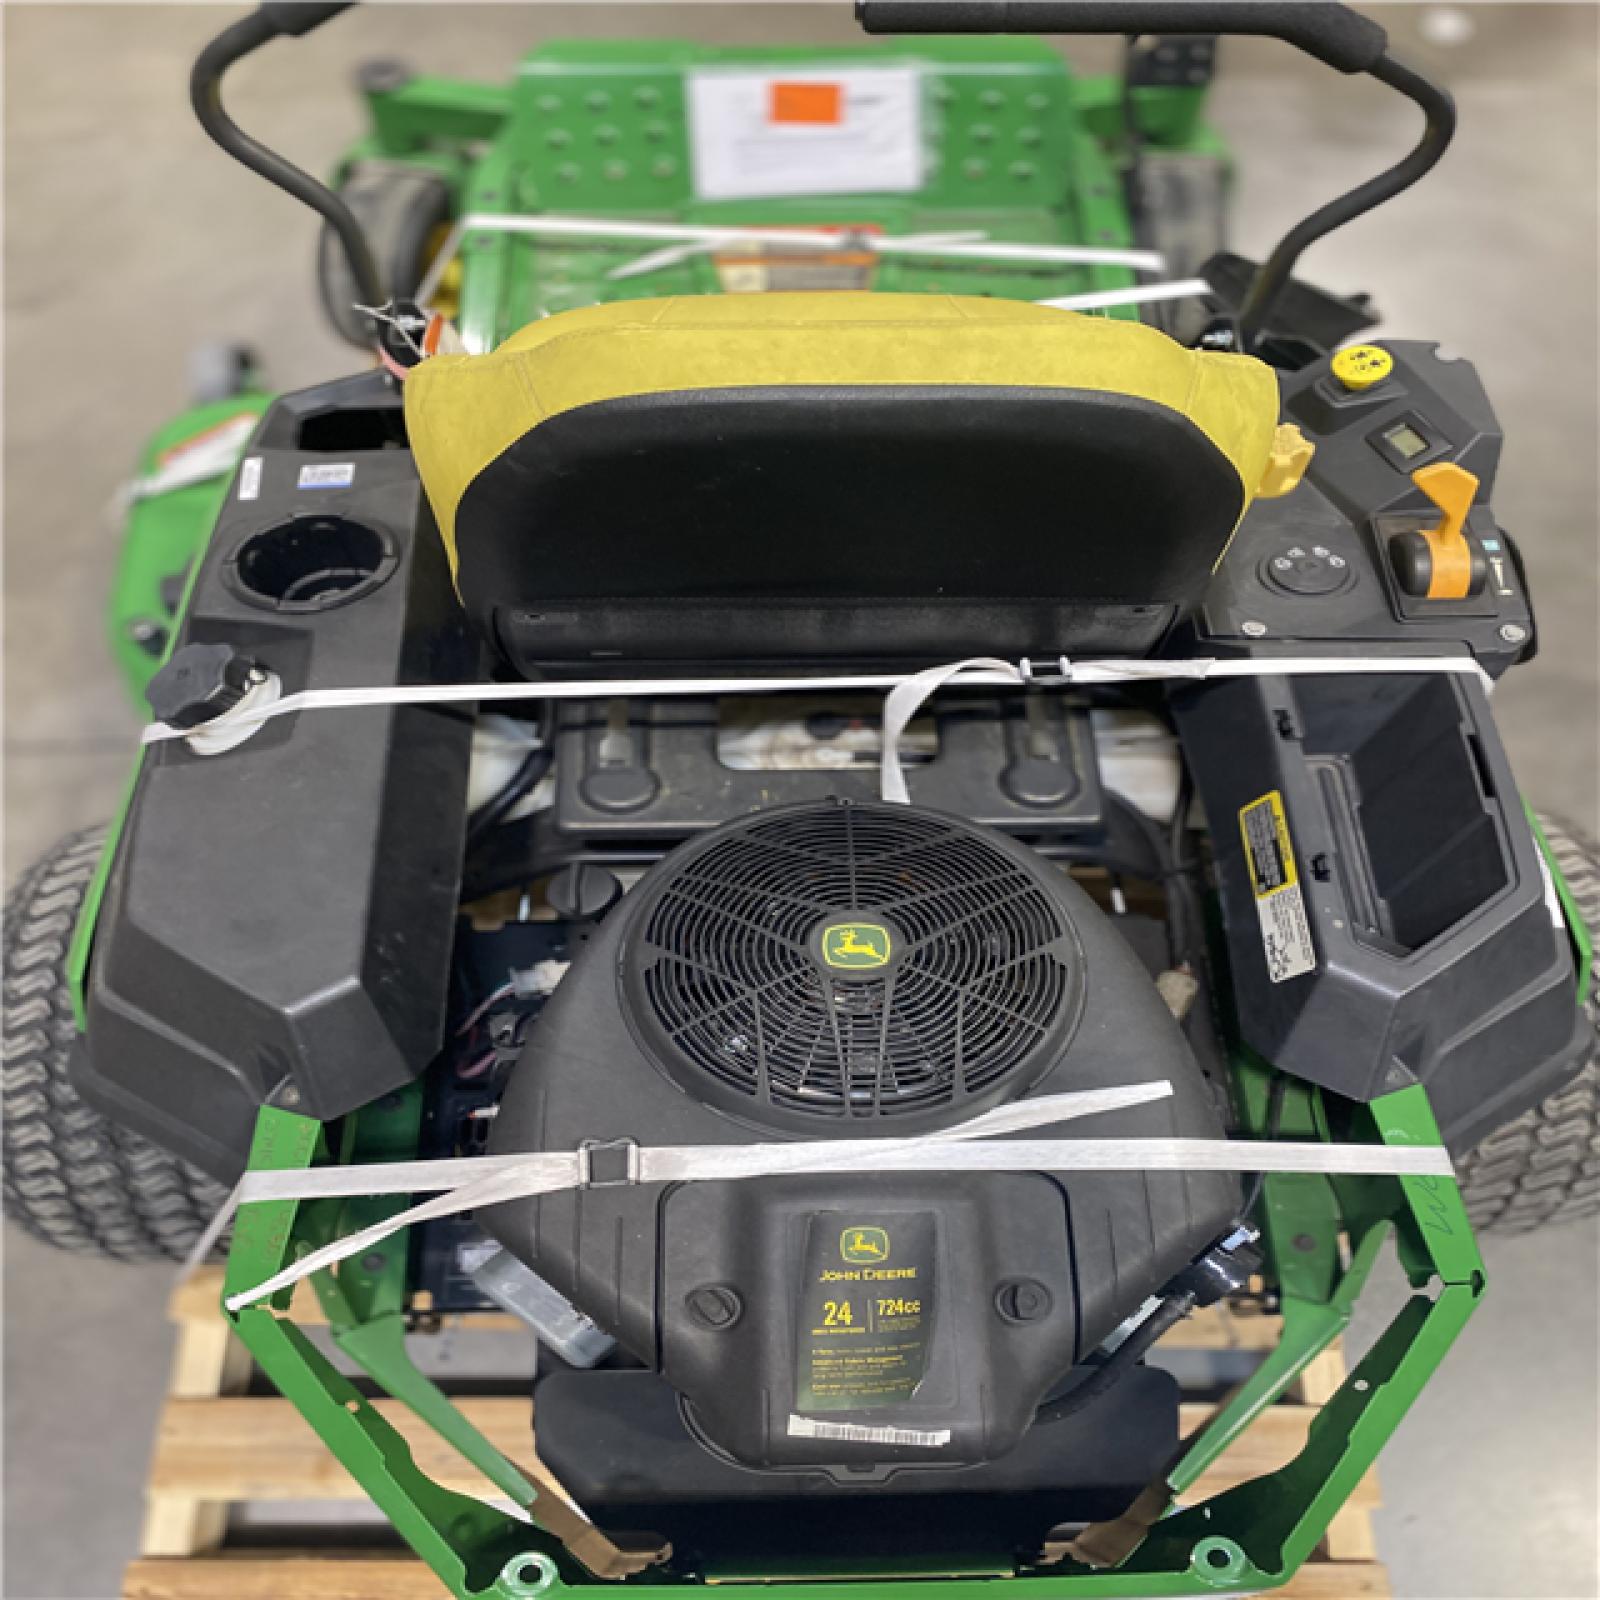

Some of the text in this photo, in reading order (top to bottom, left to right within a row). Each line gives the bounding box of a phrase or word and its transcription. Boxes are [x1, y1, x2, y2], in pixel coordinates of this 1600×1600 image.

[819, 1267, 917, 1282] JOHN DEERE
[823, 1299, 853, 1326] 24
